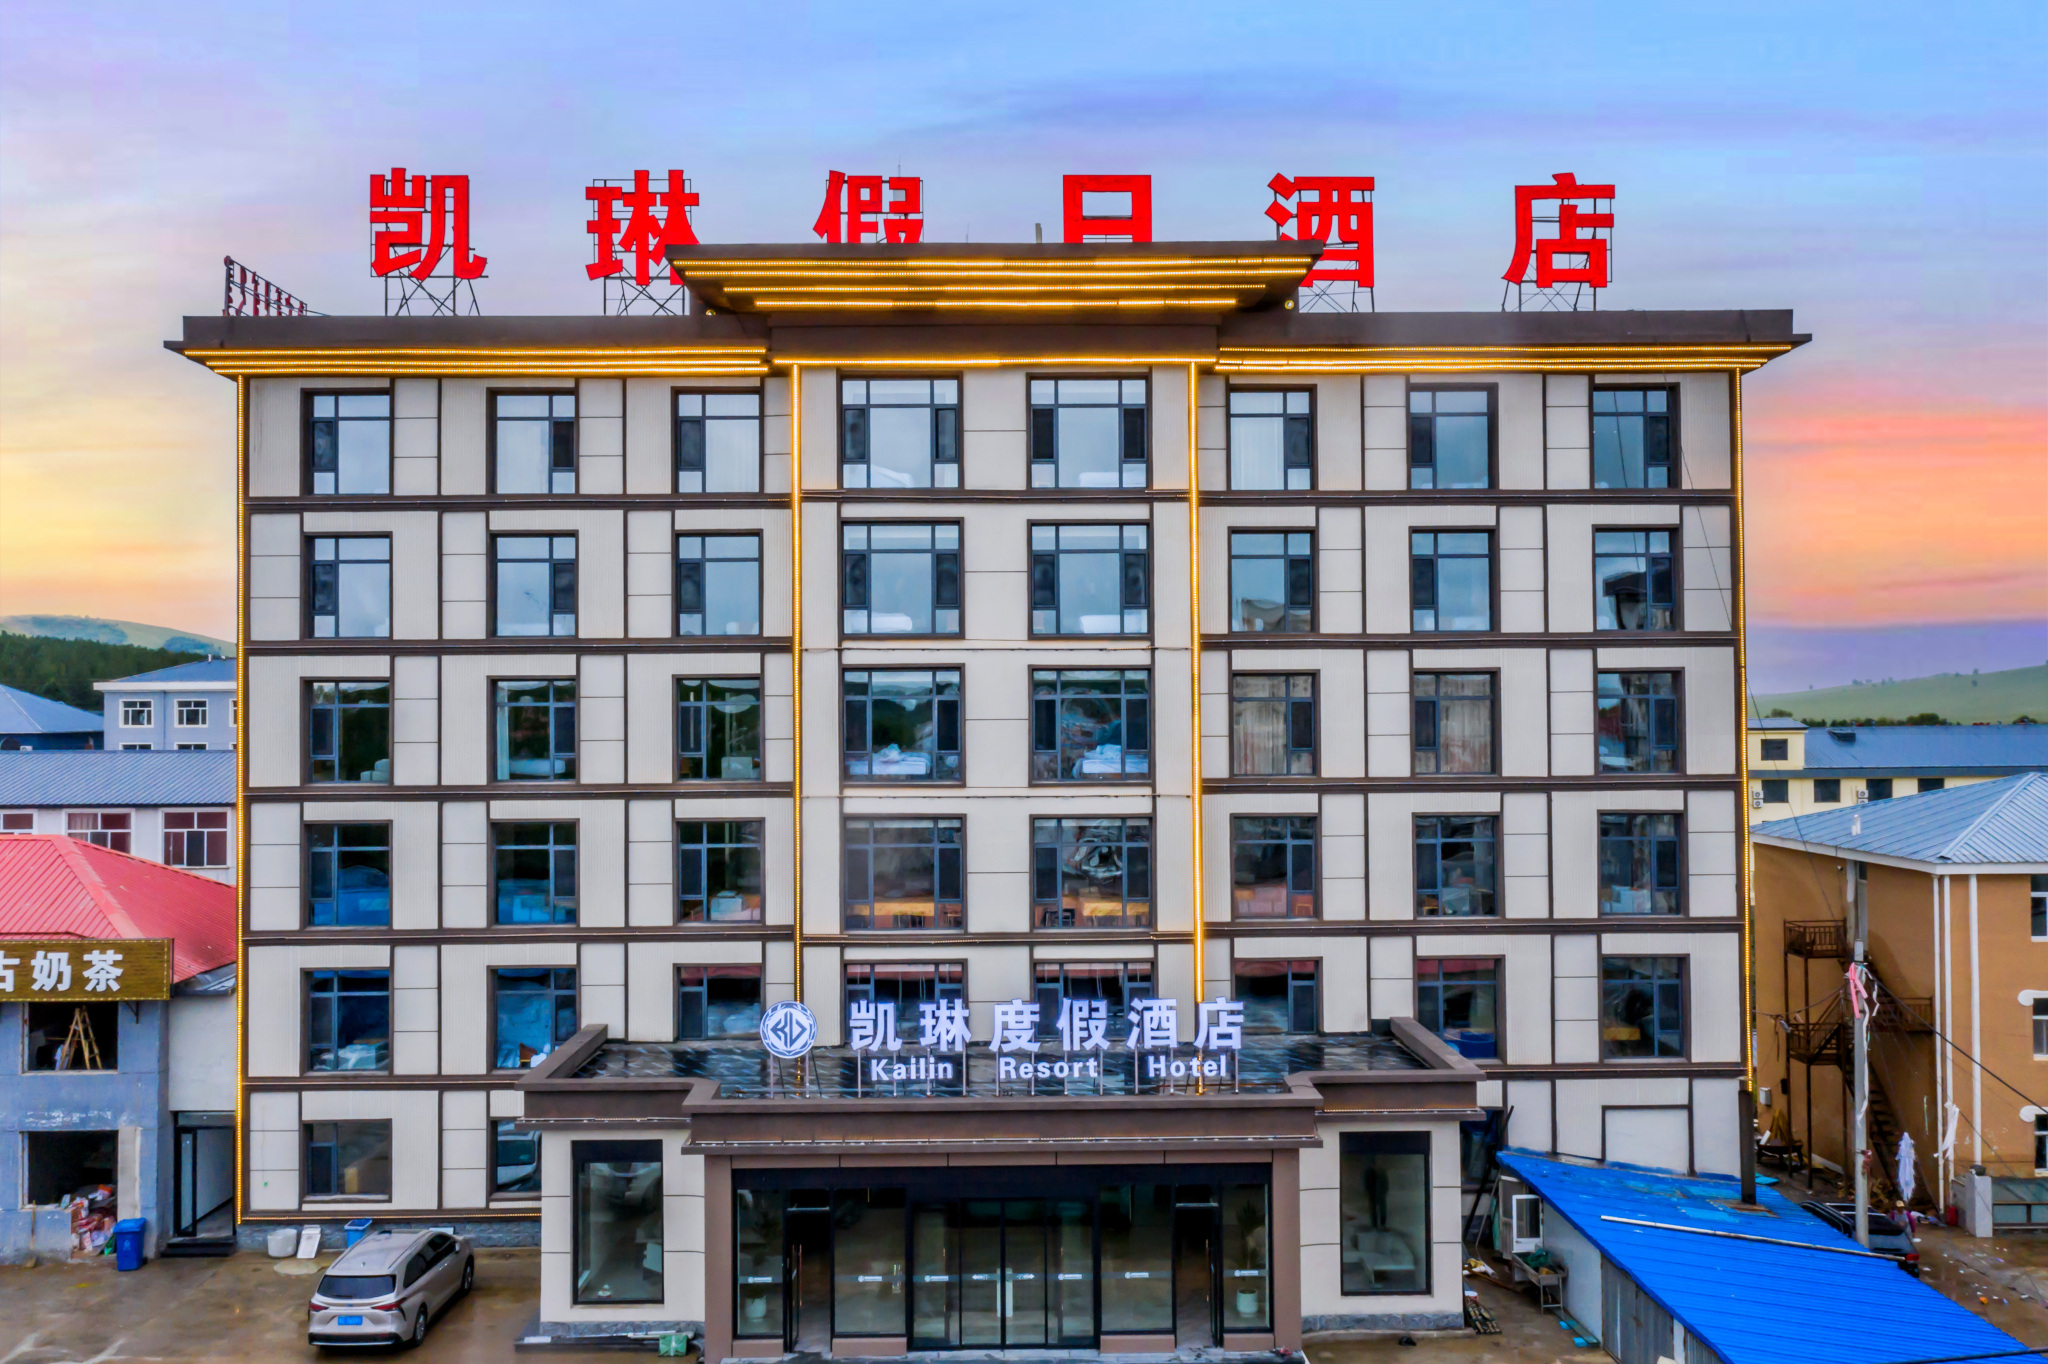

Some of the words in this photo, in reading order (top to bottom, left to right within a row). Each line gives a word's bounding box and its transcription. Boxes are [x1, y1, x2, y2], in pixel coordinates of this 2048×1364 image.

[370, 168, 1616, 286] 凯琳假日酒店
[850, 996, 1244, 1052] 凯琳度假酒店
[871, 1055, 954, 1081] Kailin
[999, 1056, 1098, 1079] Resort
[1149, 1055, 1227, 1078] Hotel
